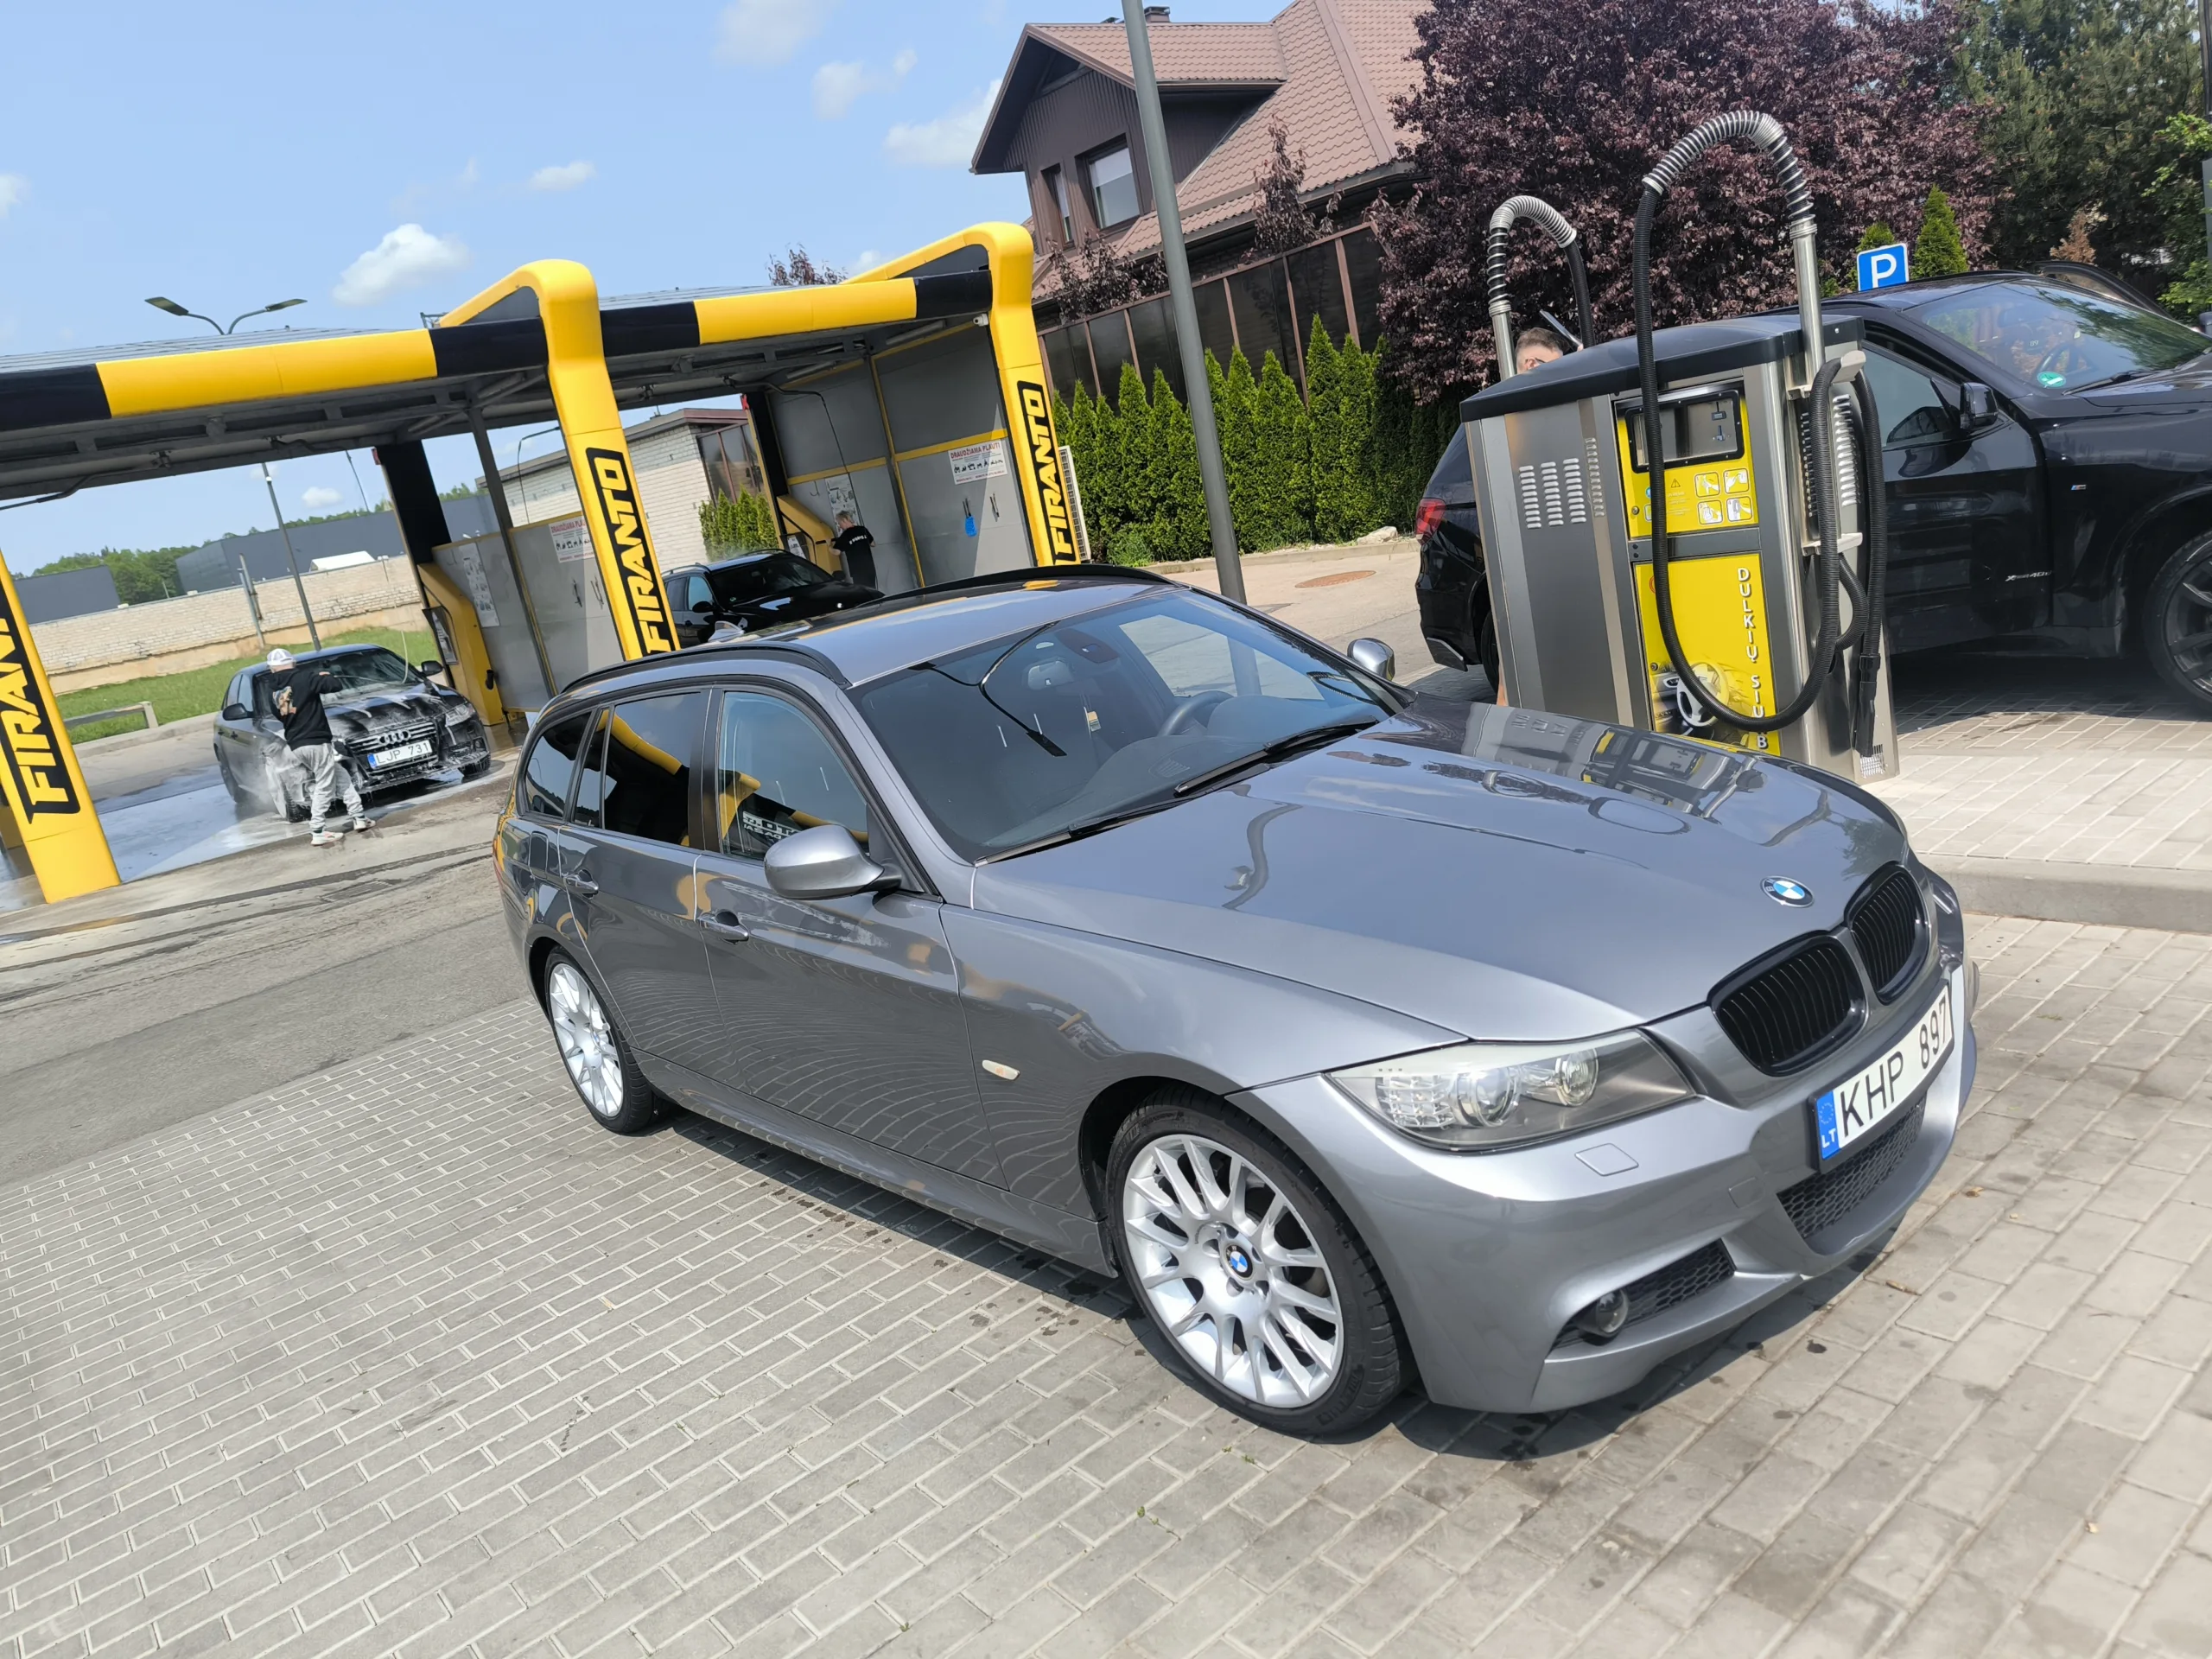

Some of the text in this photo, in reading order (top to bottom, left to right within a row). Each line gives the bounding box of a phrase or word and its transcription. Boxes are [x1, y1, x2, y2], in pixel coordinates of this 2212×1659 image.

[1871, 253, 1897, 289] P
[982, 442, 1001, 452] PLAUTI
[1022, 388, 1072, 556] FIRANTO
[594, 456, 671, 655] FIRANTO
[1737, 567, 1758, 663] DULKIŲ
[0, 617, 69, 806] FIRA
[376, 742, 429, 764] LJP 731
[1751, 675, 1768, 748] SIUB
[1840, 995, 1947, 1138] KHP 897
[1821, 1128, 1836, 1148] LT
